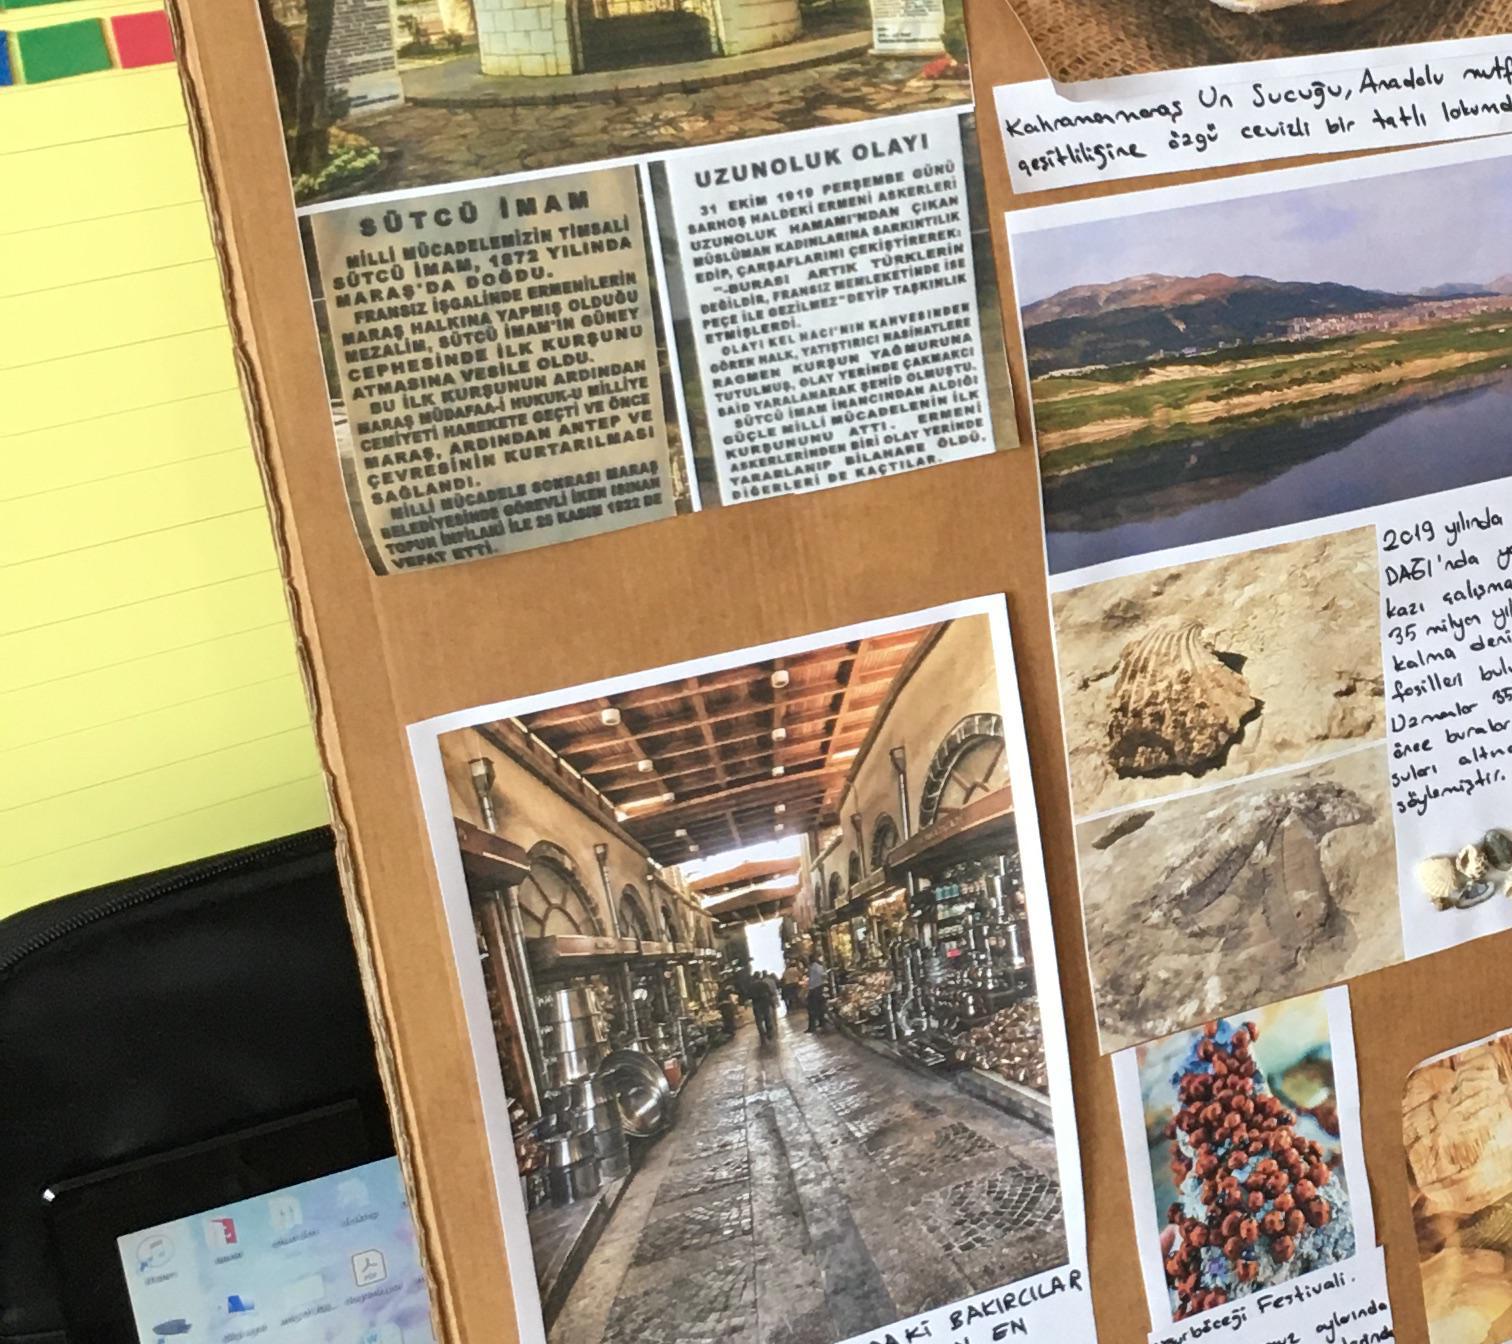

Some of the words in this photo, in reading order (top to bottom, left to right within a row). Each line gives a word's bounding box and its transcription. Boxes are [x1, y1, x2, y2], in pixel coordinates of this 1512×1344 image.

[1198, 86, 1234, 109] Un
[1358, 64, 1444, 94] Anadolu
[694, 148, 842, 189] UZUNOLUK
[852, 133, 929, 161] OLAYI
[700, 202, 718, 216] 31
[729, 194, 768, 212] EKİM
[776, 187, 814, 202] 1919
[822, 171, 904, 195] PERŞEMBE
[359, 201, 479, 237] SÜTCÜ
[499, 190, 590, 219] İMAM
[690, 227, 777, 251] UZUNOLUK
[912, 195, 959, 216] ÇIKAN
[333, 265, 404, 290] SÜTCÜ
[414, 258, 480, 278] İMAM,
[546, 237, 632, 260] YILINDA
[466, 267, 554, 289] DOĞDU.
[567, 288, 639, 311] OLDUĞU
[497, 342, 533, 359] İLK
[542, 325, 643, 352] KURŞUNU
[537, 351, 594, 371] OLDU.
[370, 399, 395, 415] BU
[402, 392, 435, 409] İLK
[1382, 520, 1436, 552] 2019
[1385, 597, 1425, 620] kazı
[1387, 622, 1417, 646] 35
[1425, 612, 1482, 642] milyon
[1391, 647, 1457, 673] kalma
[949, 1268, 1083, 1332] BAKIRCILAR
[991, 1317, 1028, 1342] EN
